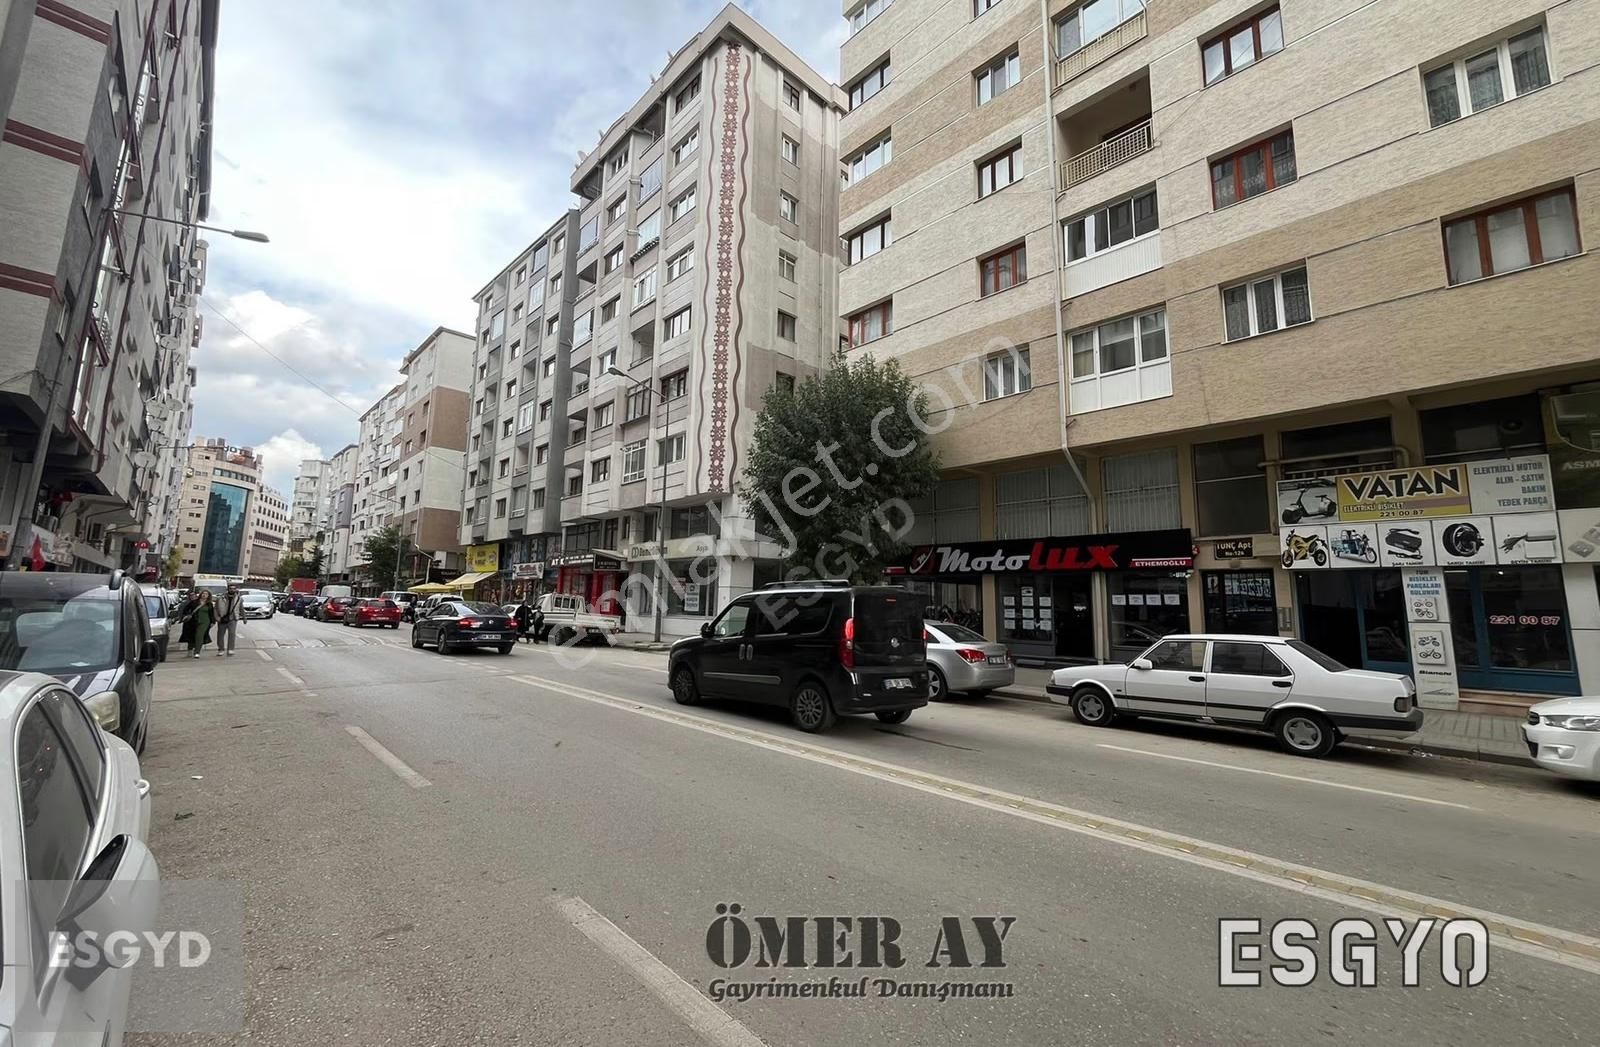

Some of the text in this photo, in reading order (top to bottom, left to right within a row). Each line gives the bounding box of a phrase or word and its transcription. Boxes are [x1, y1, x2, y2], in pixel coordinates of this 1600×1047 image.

[1516, 462, 1543, 472] MOTOR
[1496, 476, 1514, 484] ALIM
[1521, 473, 1545, 483] SATIM
[1343, 468, 1461, 501] VATAN
[1521, 484, 1546, 494] BAKIM
[1497, 496, 1548, 507] YEDEK PARÇA
[1489, 615, 1561, 626] 221 00 87
